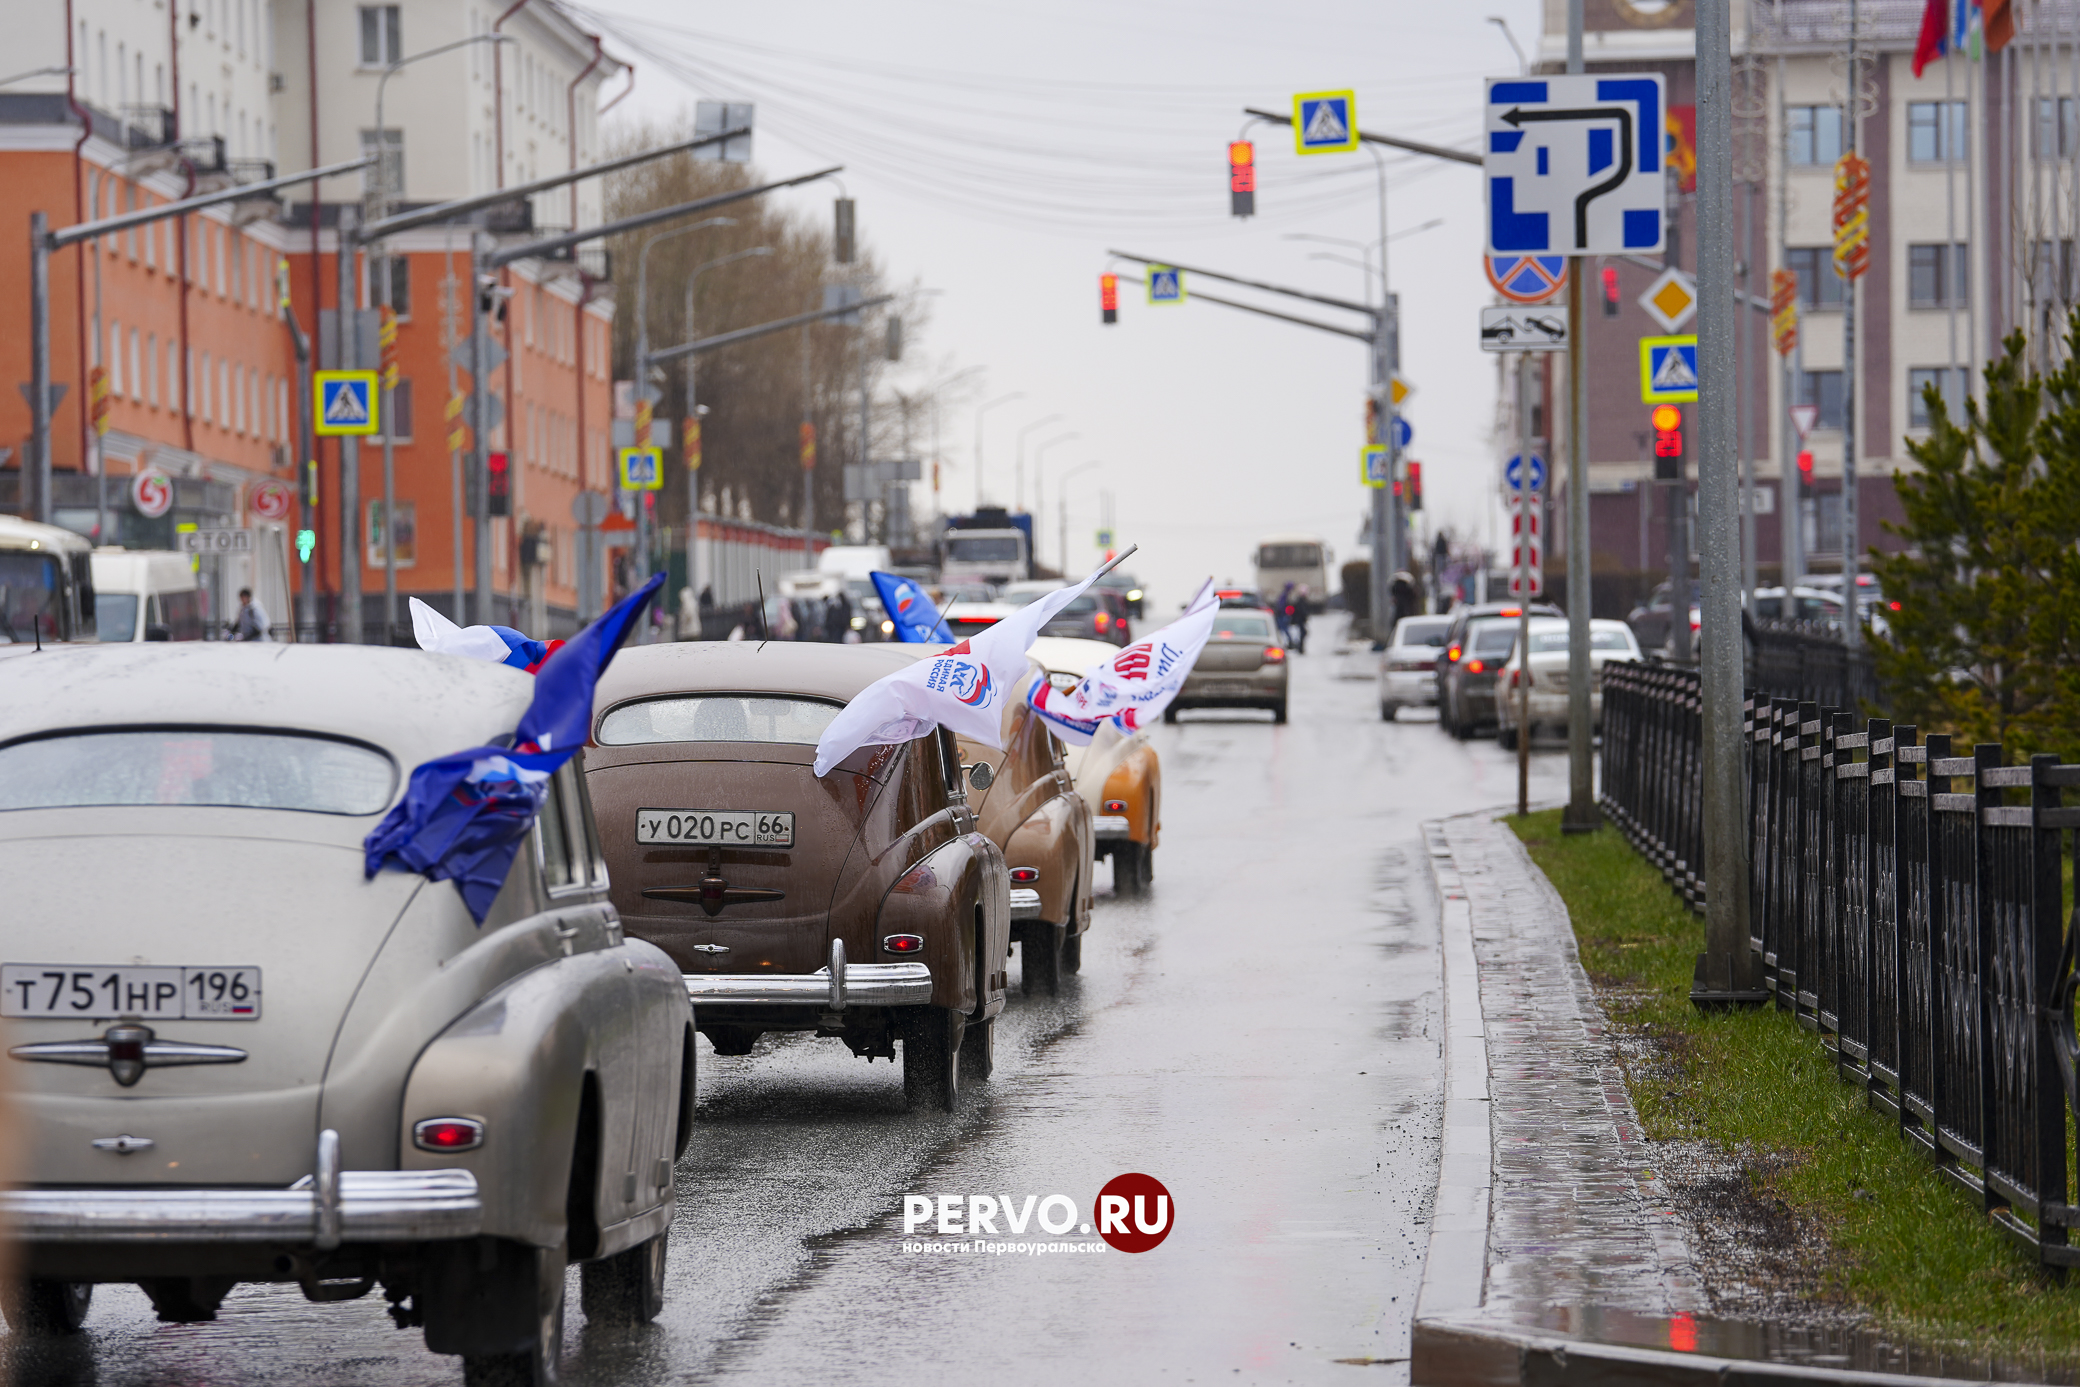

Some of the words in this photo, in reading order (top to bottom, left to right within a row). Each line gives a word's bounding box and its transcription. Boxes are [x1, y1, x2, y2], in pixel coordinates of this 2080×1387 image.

[927, 659, 945, 689] РОССИЯ
[936, 659, 954, 692] ЕДИНАЯ
[757, 834, 775, 842] RUS
[758, 815, 784, 834] 66
[189, 972, 249, 1001] 196
